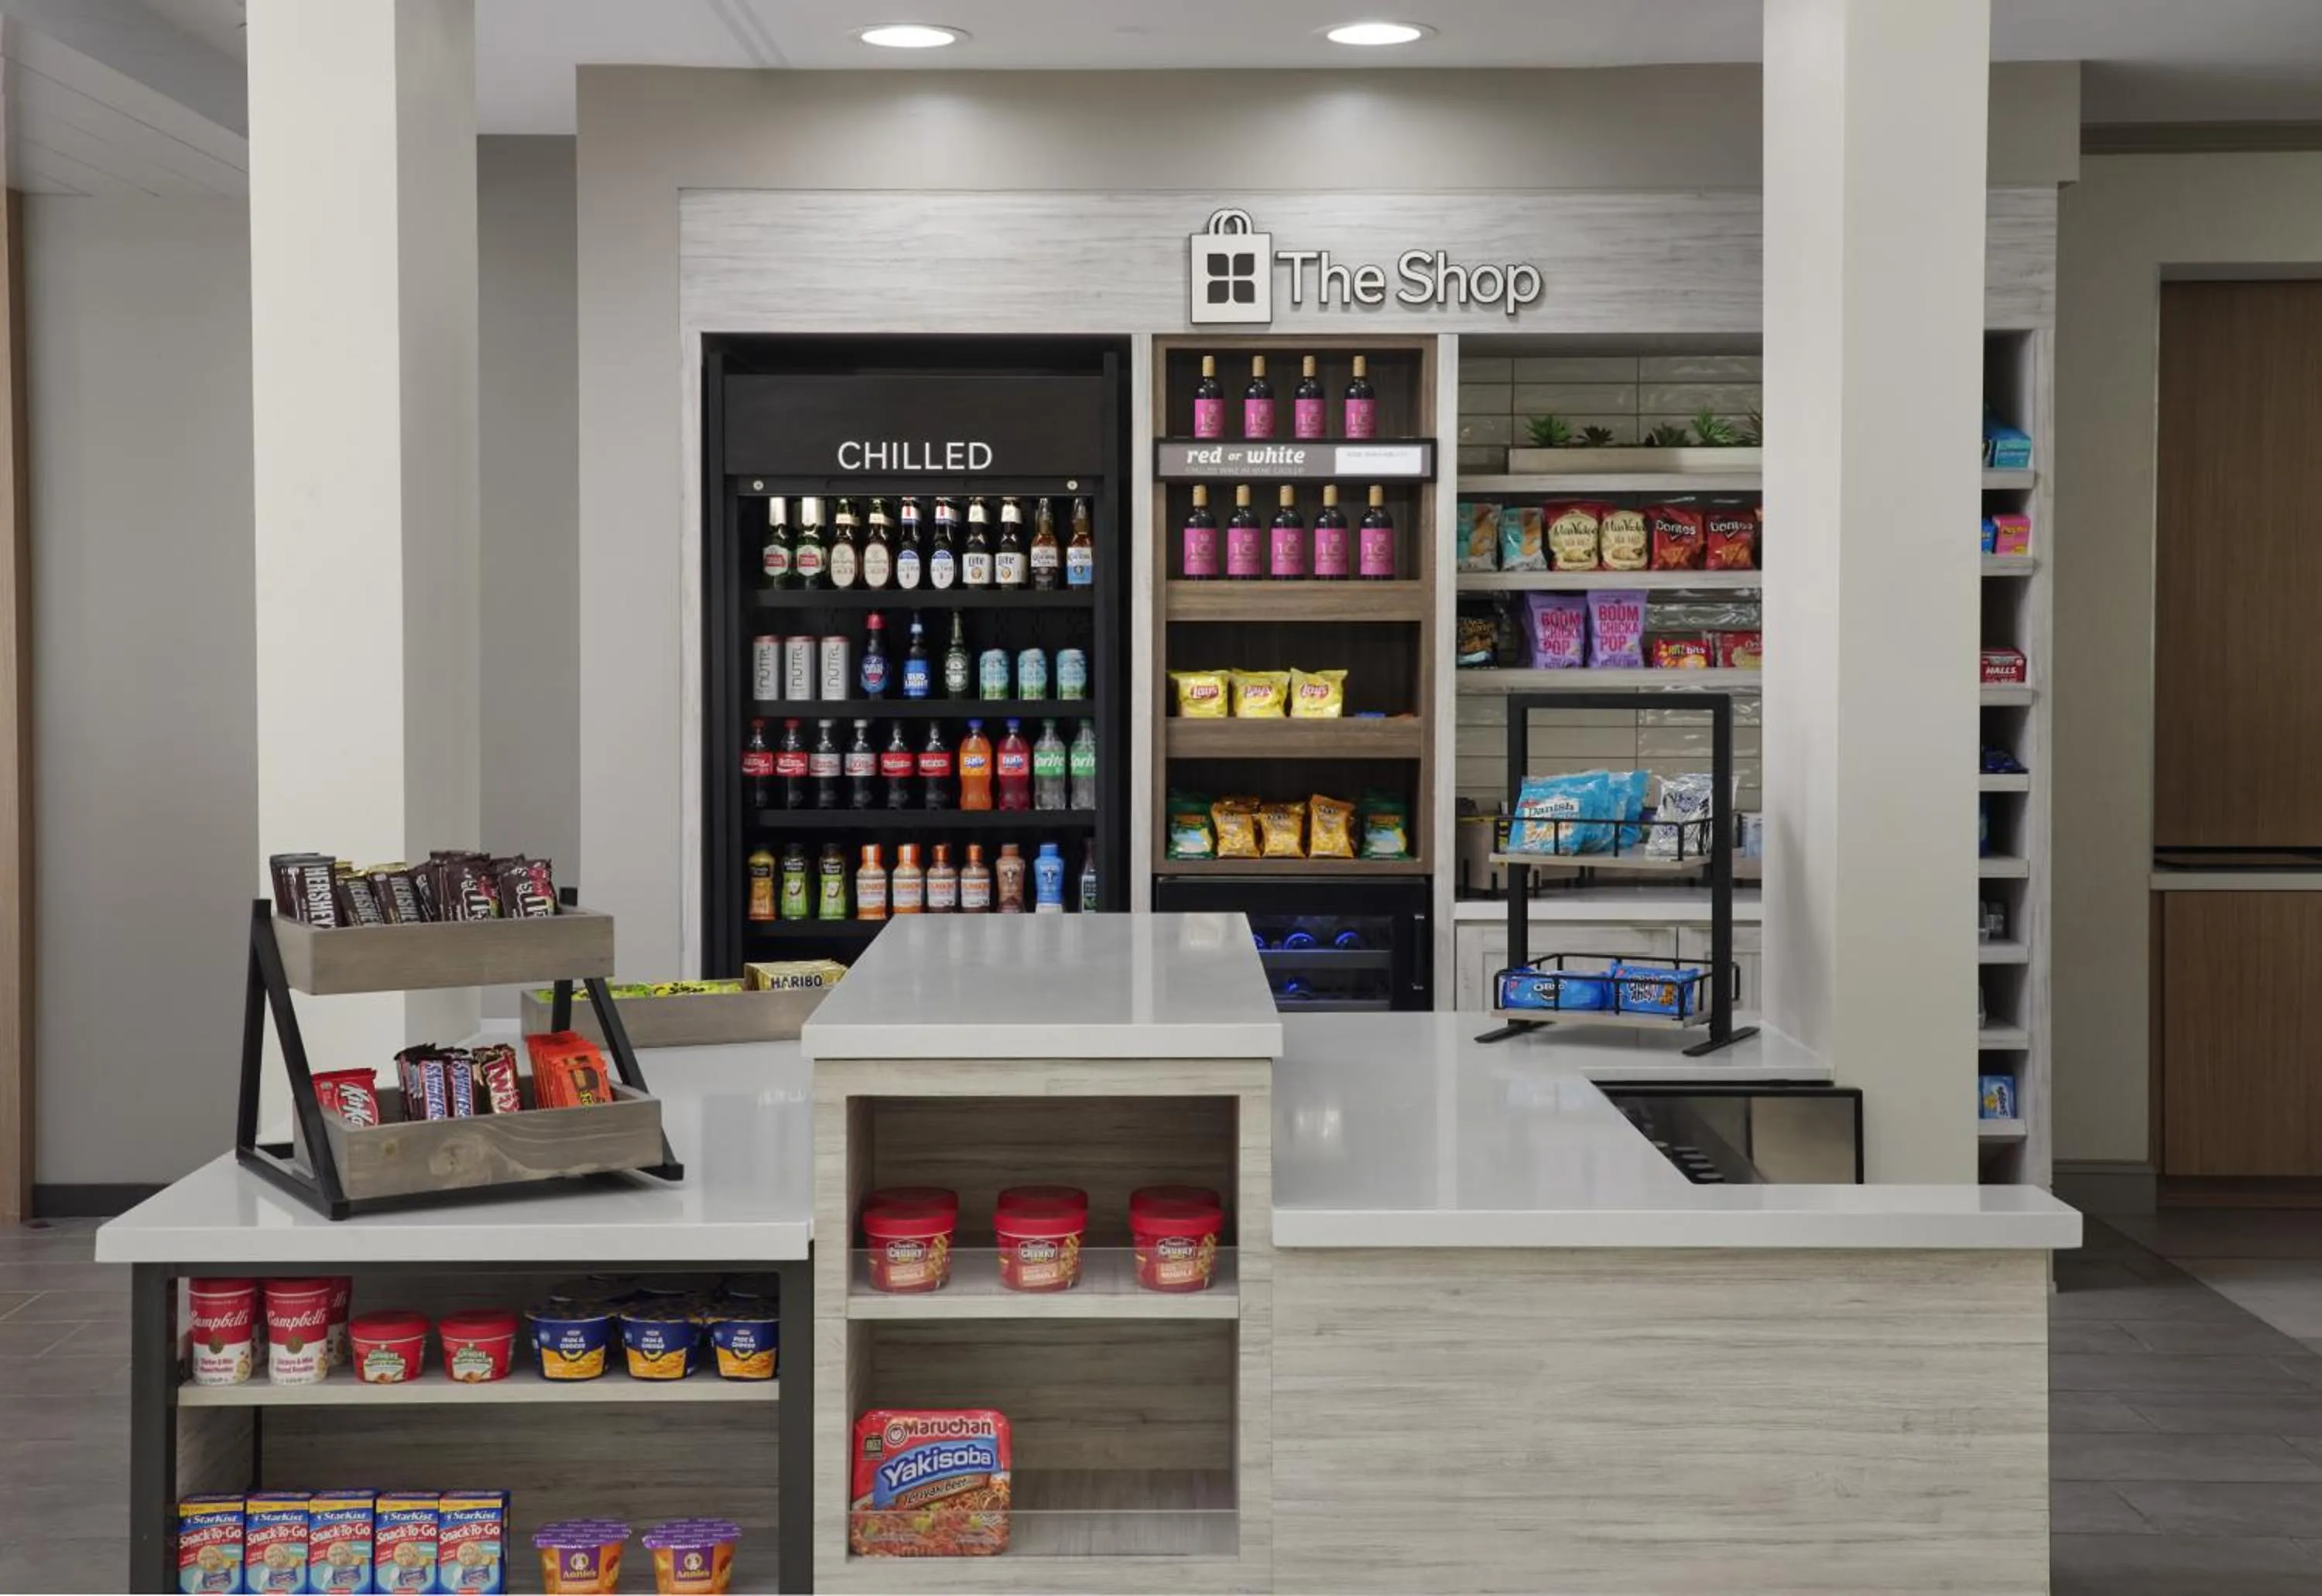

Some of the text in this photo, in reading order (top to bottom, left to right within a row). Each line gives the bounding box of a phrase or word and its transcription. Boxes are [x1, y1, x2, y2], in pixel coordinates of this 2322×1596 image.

[1275, 249, 1543, 314] The Shop
[837, 441, 993, 470] CHILLED
[1187, 447, 1306, 464] red or white
[1656, 520, 1697, 535] Doritos
[1542, 611, 1582, 627] BOOM
[1598, 605, 1639, 621] BOOM
[1600, 621, 1639, 635] CHICKA
[1543, 640, 1570, 656] POP
[1600, 635, 1627, 652] POP
[348, 881, 381, 923] HERSHE
[389, 876, 422, 921] HERSHE
[770, 974, 823, 989] HARIBO
[906, 1418, 992, 1436] Maruchan
[883, 1447, 992, 1488] Yakisoba
[945, 1478, 968, 1492] Beef
[193, 1514, 238, 1524] StarKist
[259, 1512, 303, 1522] StarKist
[323, 1511, 366, 1521] StarKist
[390, 1512, 433, 1521] StarKist
[453, 1510, 496, 1519] StarKist
[563, 1570, 597, 1580] Annie's
[676, 1570, 711, 1579] Annie's
